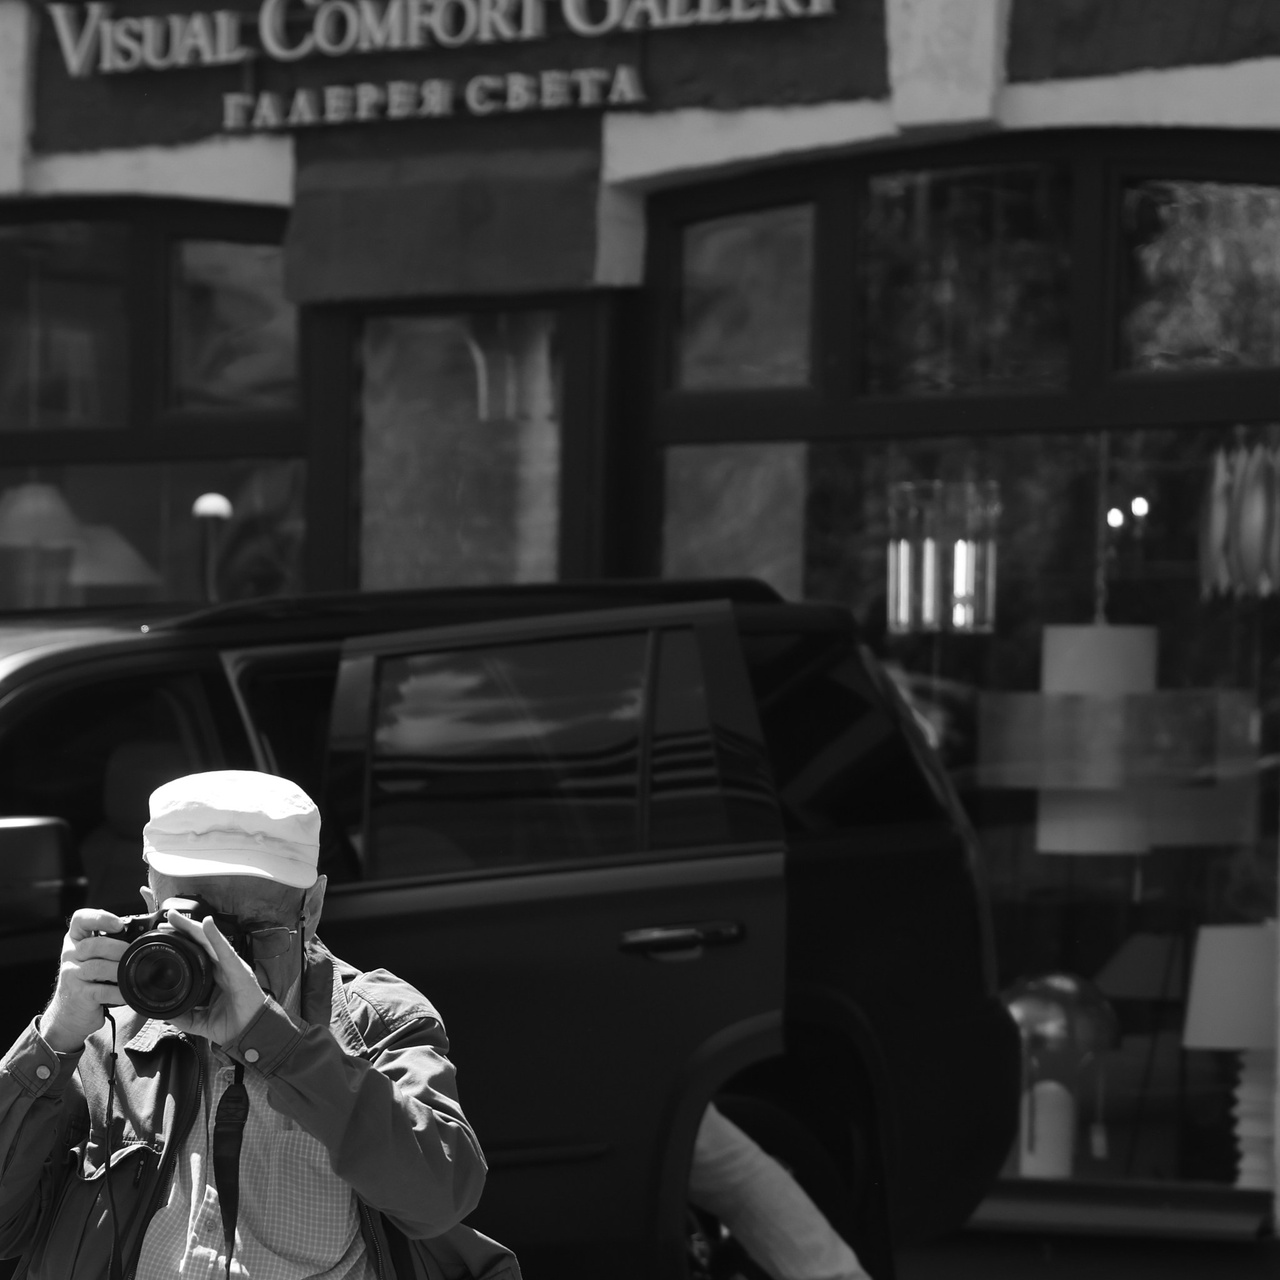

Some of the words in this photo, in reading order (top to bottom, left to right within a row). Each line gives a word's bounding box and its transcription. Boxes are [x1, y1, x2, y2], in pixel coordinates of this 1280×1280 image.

[48, 2, 252, 77] VISUAL
[260, 0, 546, 61] COMFORT
[222, 79, 454, 129] ГАЛЕРЕЯ
[466, 65, 645, 115] СВЕТА
